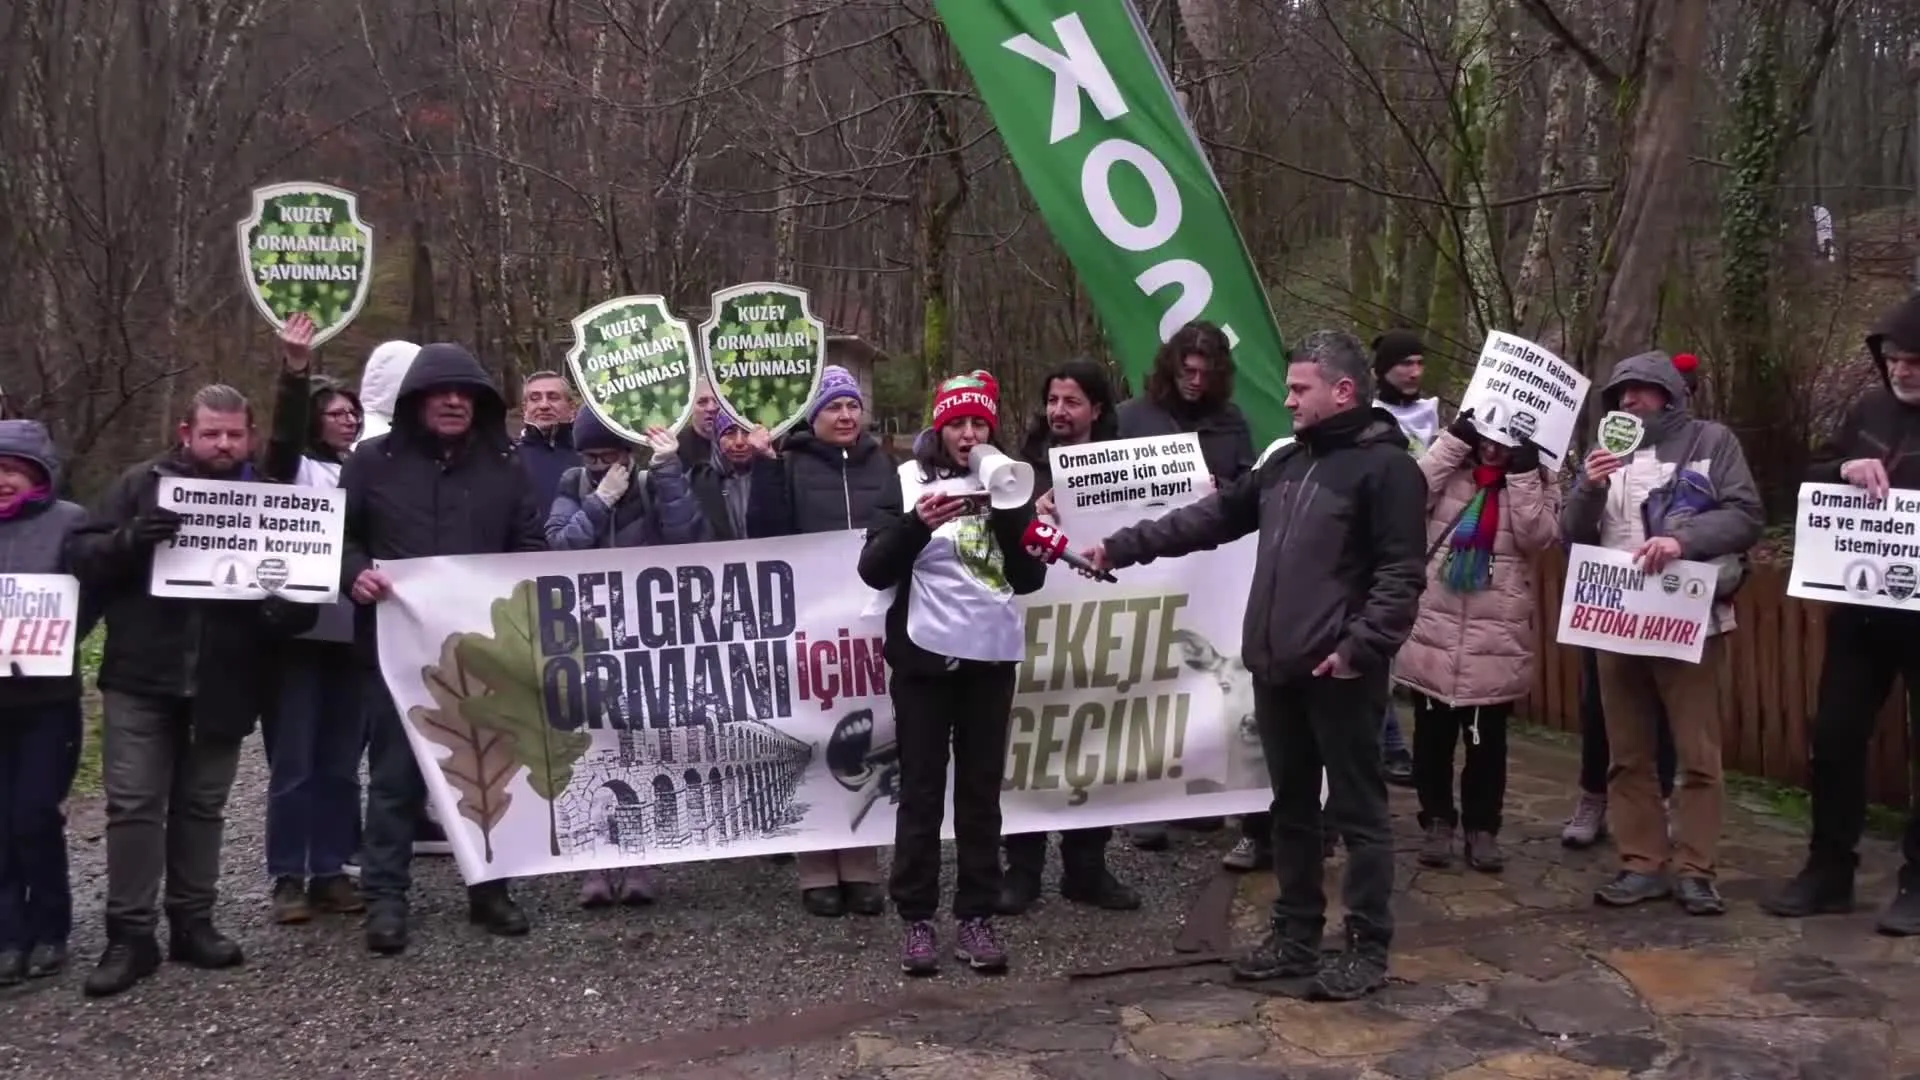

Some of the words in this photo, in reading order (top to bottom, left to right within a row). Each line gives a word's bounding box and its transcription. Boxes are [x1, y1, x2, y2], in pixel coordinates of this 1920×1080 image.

[280, 206, 333, 223] KUZEY
[257, 235, 357, 252] ORMANLARI
[259, 263, 357, 281] SAVUNMASI
[600, 314, 648, 341] KUZEY
[738, 304, 787, 322] KUZEY
[586, 335, 679, 372] ORMANLARI
[716, 333, 811, 351] ORMANLARI
[596, 360, 686, 398] SAVUNMASI
[719, 359, 811, 379] SAVUNMASI
[1546, 360, 1577, 390] talana
[1486, 377, 1512, 395] geri
[1512, 388, 1551, 414] çekin!
[1497, 359, 1577, 412] yönetmelikleri
[1059, 448, 1129, 469] Ormanları
[1133, 444, 1158, 461] yok
[1161, 441, 1195, 457] eden
[1067, 468, 1128, 489] sermaye
[1133, 463, 1157, 480] için
[1161, 460, 1196, 475] odun
[173, 486, 257, 508] Ormanları
[263, 492, 335, 514] arabaya,
[1076, 486, 1146, 508] üretimine
[1151, 477, 1192, 498] hayır!
[180, 512, 252, 530] mangala
[259, 514, 326, 535] kapatın,
[1808, 512, 1831, 531] taş
[1837, 516, 1855, 530] ve
[1860, 517, 1915, 535] maden
[168, 534, 258, 552] yangından
[265, 536, 332, 555] koruyun
[1578, 560, 1645, 591] ORMANI
[535, 560, 796, 656] BELGRAD
[1574, 582, 1626, 612] KAYIR,
[10, 619, 71, 656] ELE!
[1570, 605, 1639, 639] BETONA
[1640, 616, 1702, 646] HAYIR!
[1017, 594, 1189, 694] EKETE
[542, 640, 793, 733] ORMANI
[795, 628, 887, 711] İÇİN
[1001, 680, 1190, 806] GEÇİN!
